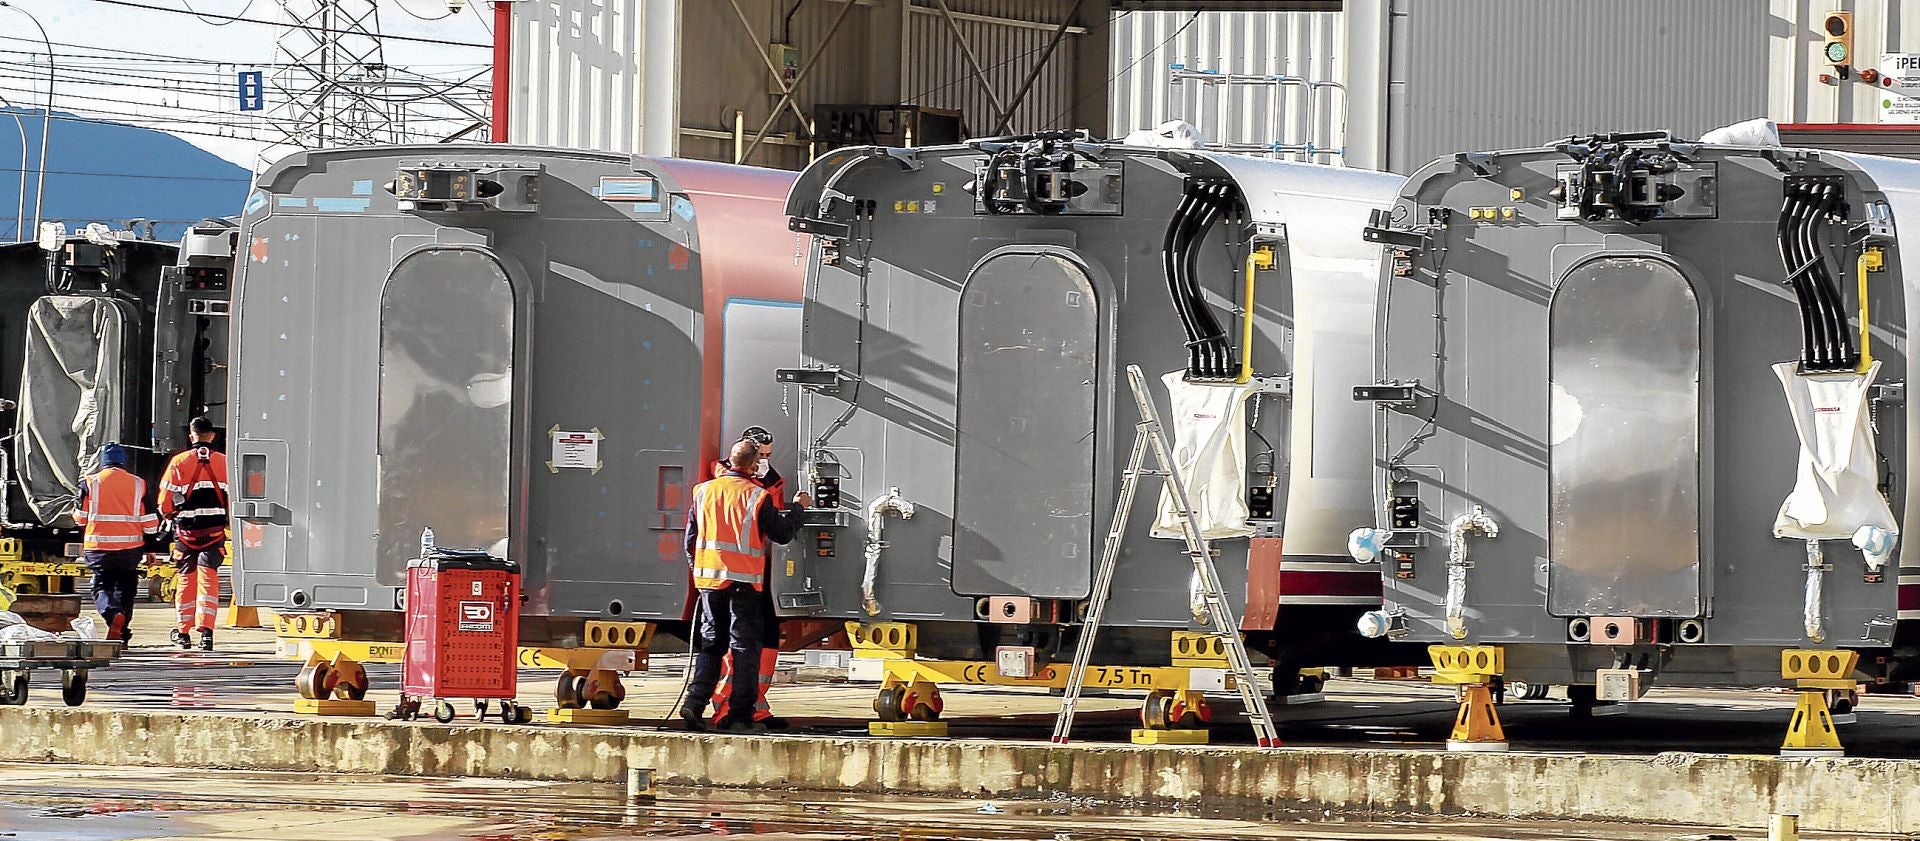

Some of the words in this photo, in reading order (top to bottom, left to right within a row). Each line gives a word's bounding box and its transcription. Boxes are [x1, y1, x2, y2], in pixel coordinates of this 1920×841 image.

[1896, 57, 1920, 69] ¡PE
[519, 649, 541, 666] CE
[963, 665, 986, 682] CE
[1097, 668, 1124, 686] 7,5
[1129, 669, 1151, 684] Tn
